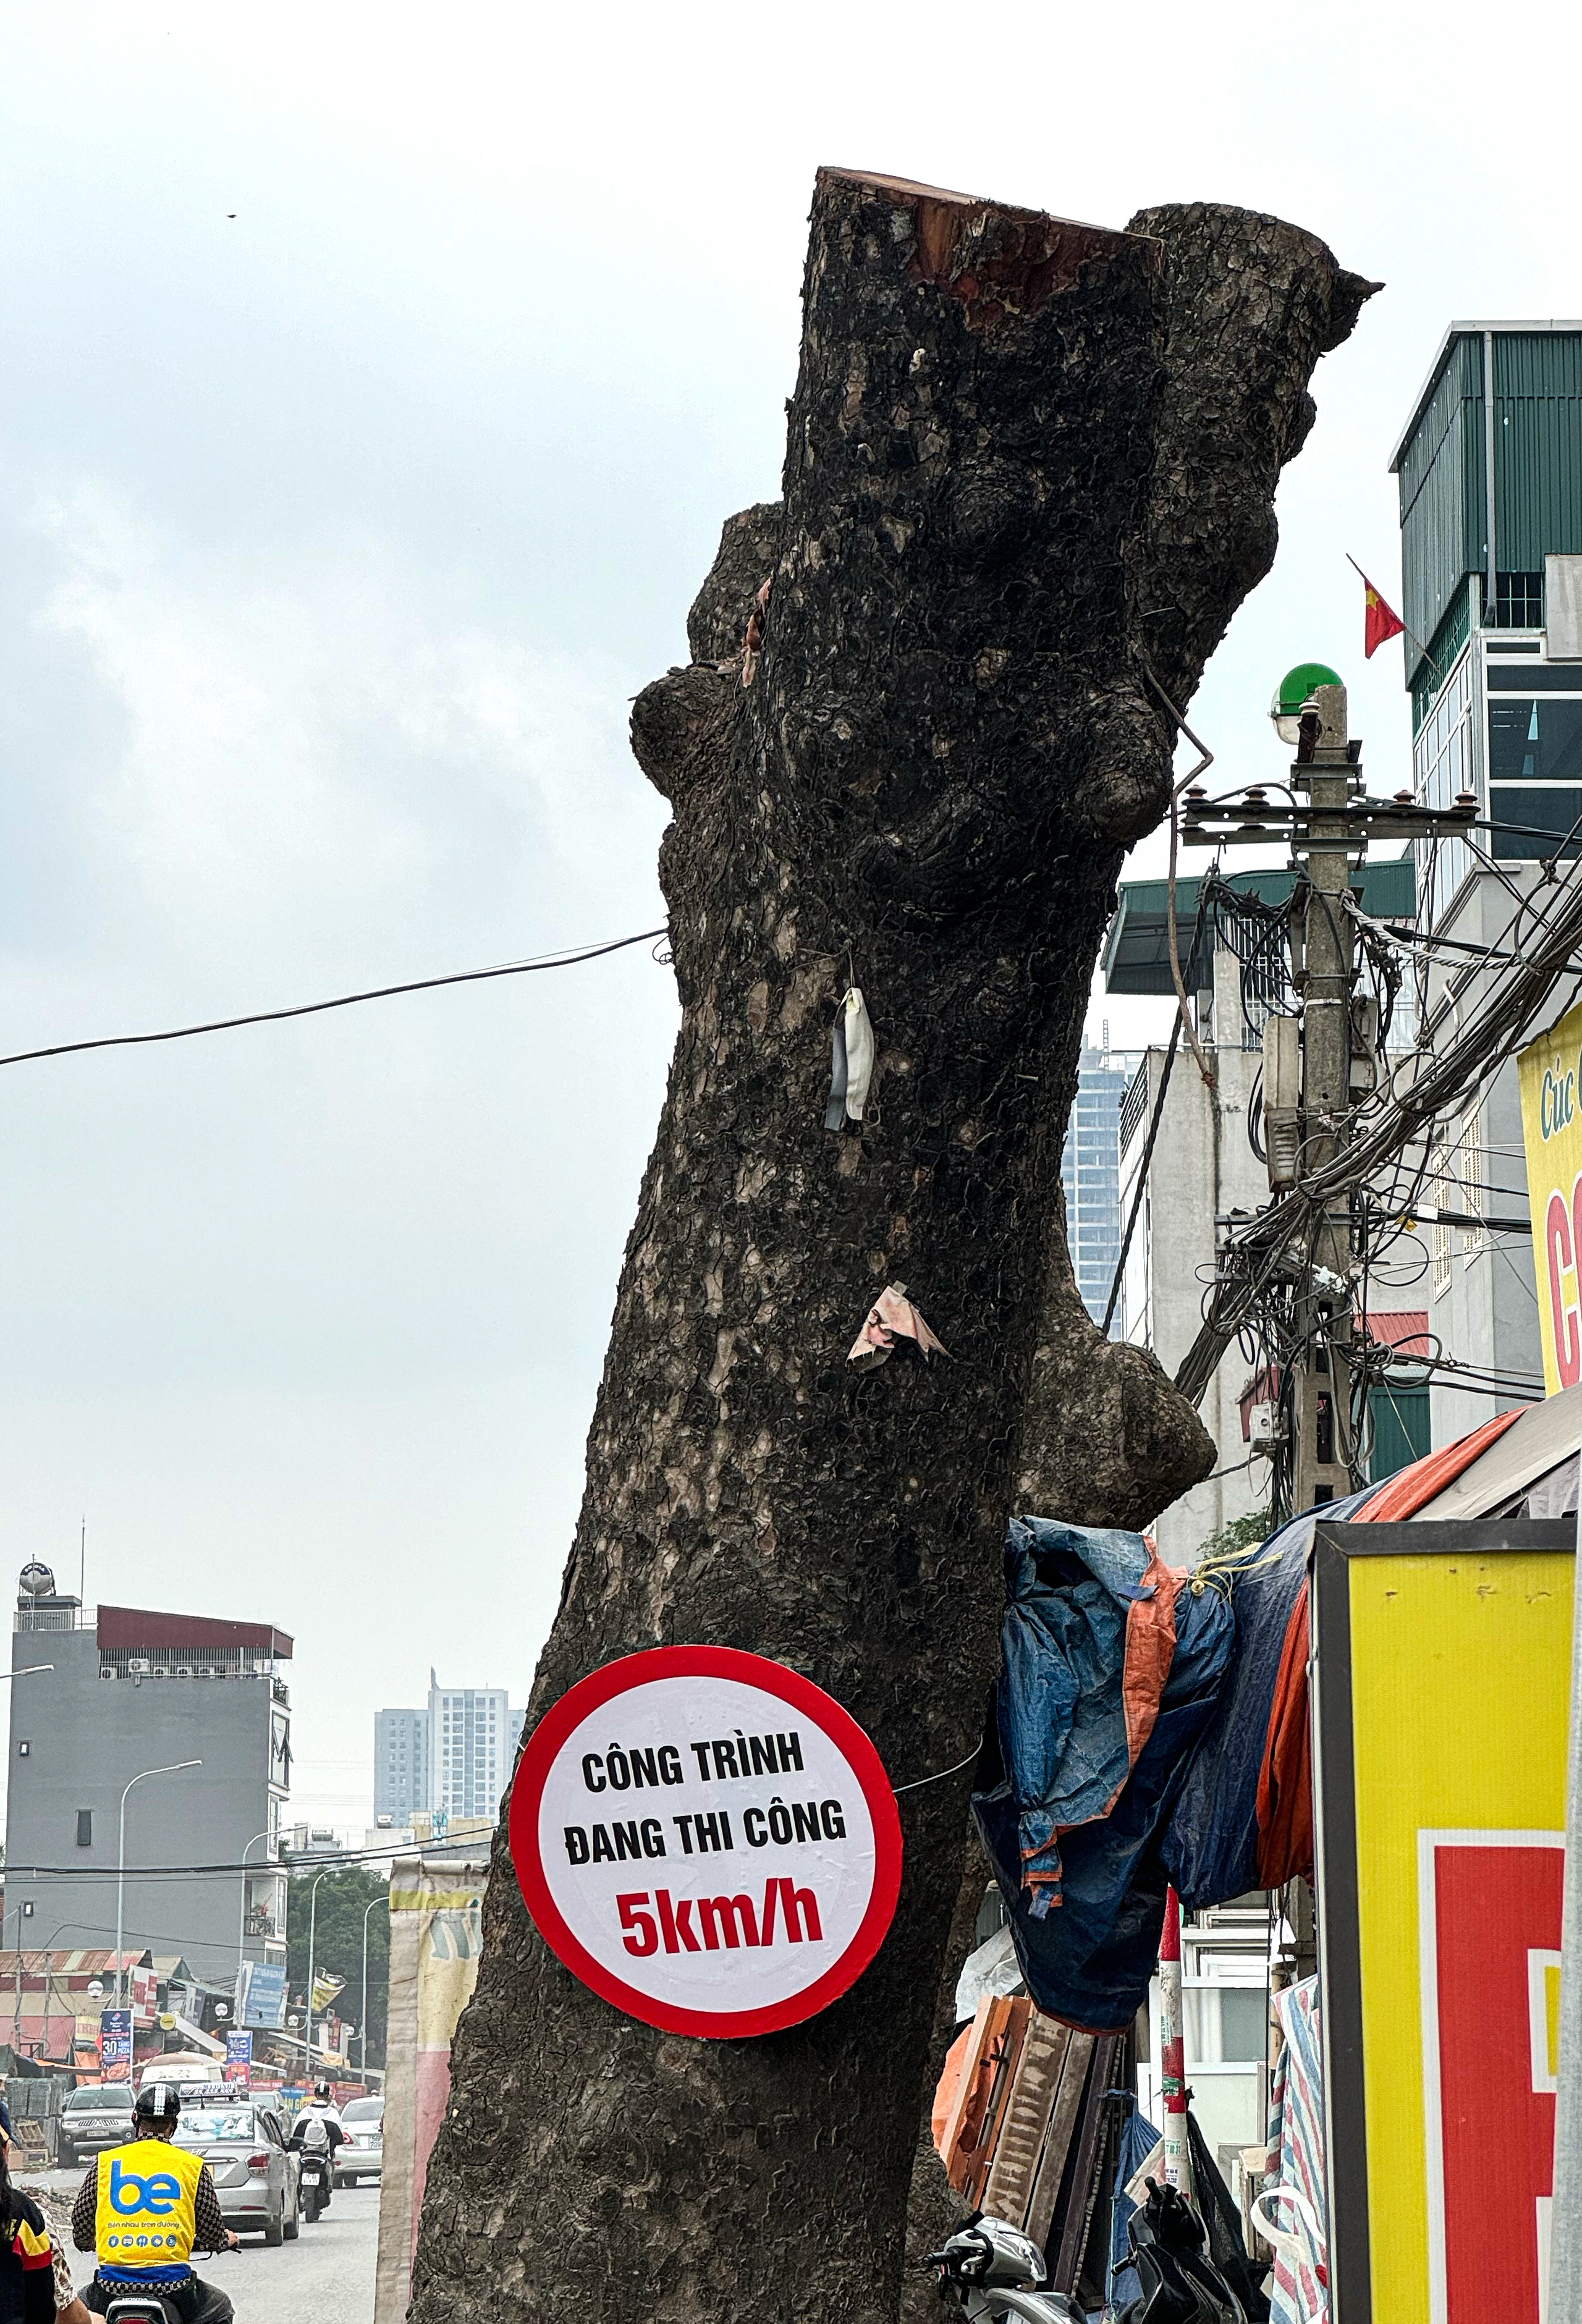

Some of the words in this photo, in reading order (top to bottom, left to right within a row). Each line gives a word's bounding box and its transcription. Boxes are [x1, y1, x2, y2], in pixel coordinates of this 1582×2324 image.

[1541, 1055, 1575, 1141] Cúc
[582, 1743, 683, 1793] CÔNG
[691, 1729, 804, 1781] TRÌNH
[564, 1817, 667, 1866] ĐANG
[673, 1811, 734, 1856] THI
[743, 1797, 847, 1848] CÔNG
[615, 1877, 823, 1957] 5km/h
[103, 2040, 117, 2056] 30
[110, 2160, 180, 2215] be
